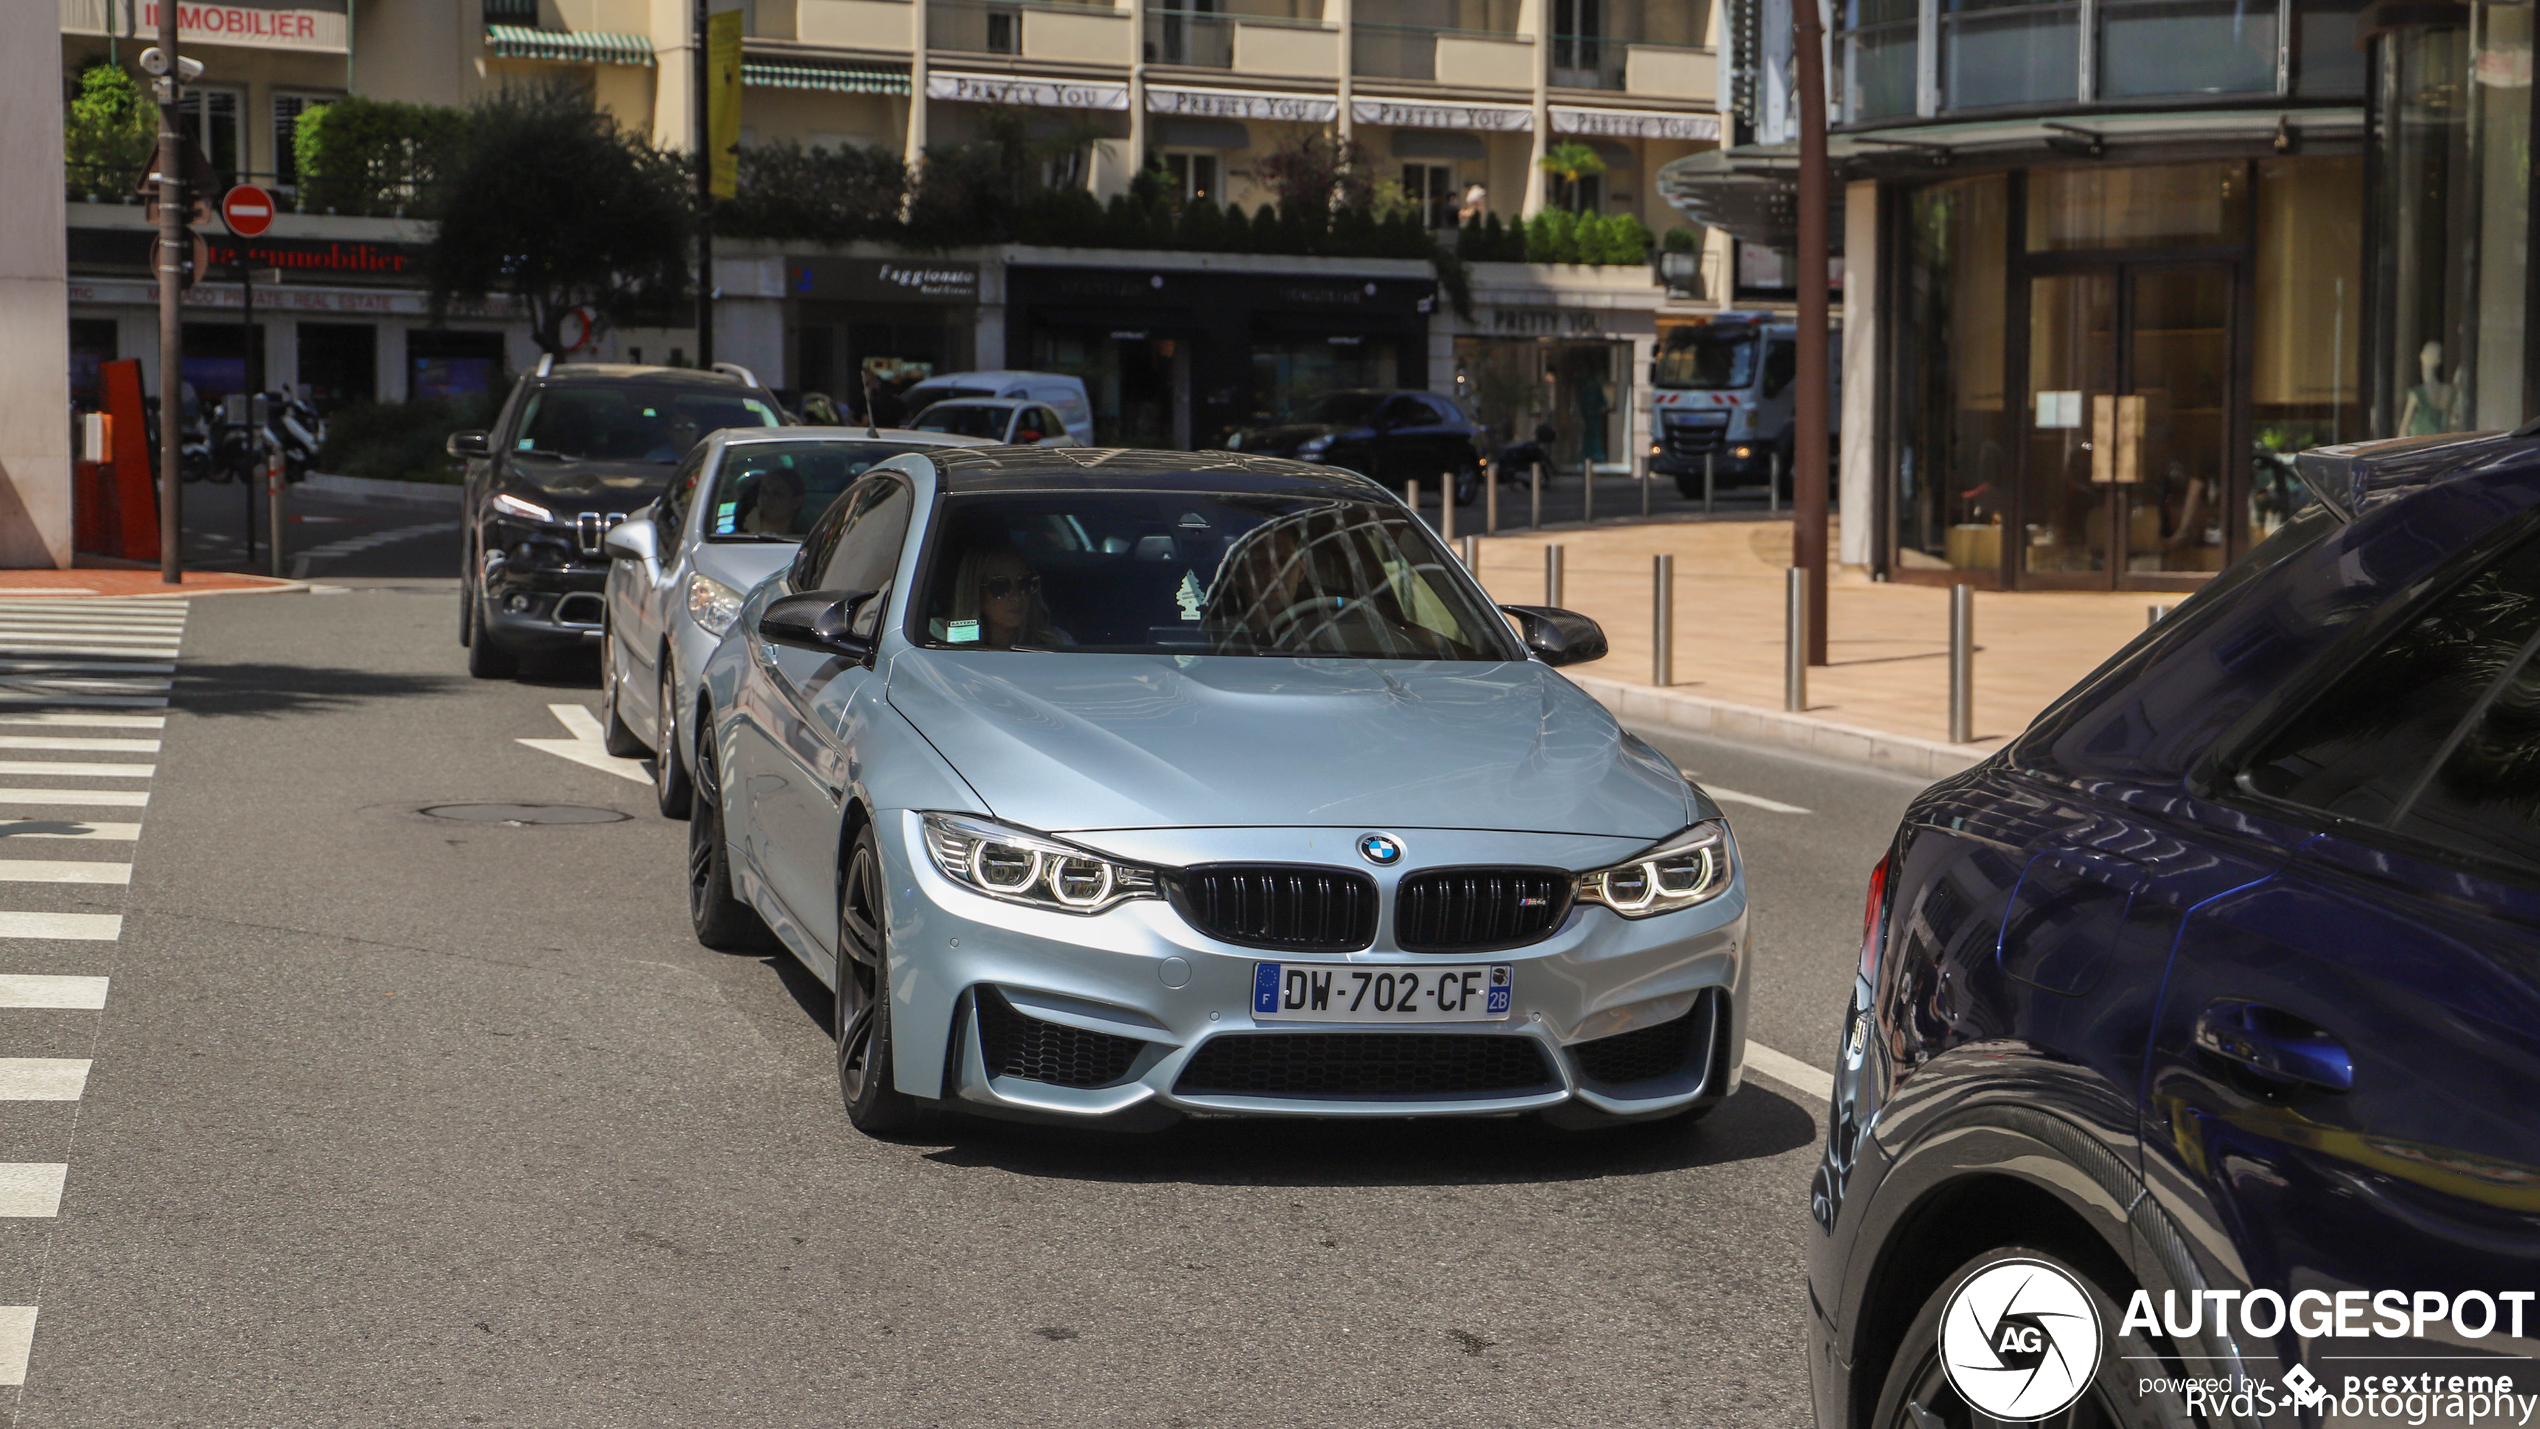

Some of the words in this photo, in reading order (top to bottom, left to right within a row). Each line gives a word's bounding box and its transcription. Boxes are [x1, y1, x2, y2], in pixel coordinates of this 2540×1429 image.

[145, 3, 315, 38] IMOBILIER
[956, 78, 1038, 105] PRETTY
[1051, 84, 1097, 107] YOU
[1176, 92, 1253, 117] PRETTY
[1266, 98, 1307, 119] YOU
[1379, 103, 1452, 128] PRETTY
[1466, 109, 1504, 129] YOU
[1577, 113, 1645, 138] PRETTY
[1656, 117, 1693, 138] YOU
[879, 264, 975, 287] Faggionato
[147, 286, 214, 304] MACO
[1493, 309, 1559, 331] PRETTY
[1567, 310, 1602, 333] YOU
[1262, 993, 1271, 1006] F
[1284, 969, 1482, 1013] DW-702-CF
[1488, 991, 1509, 1011] 2B
